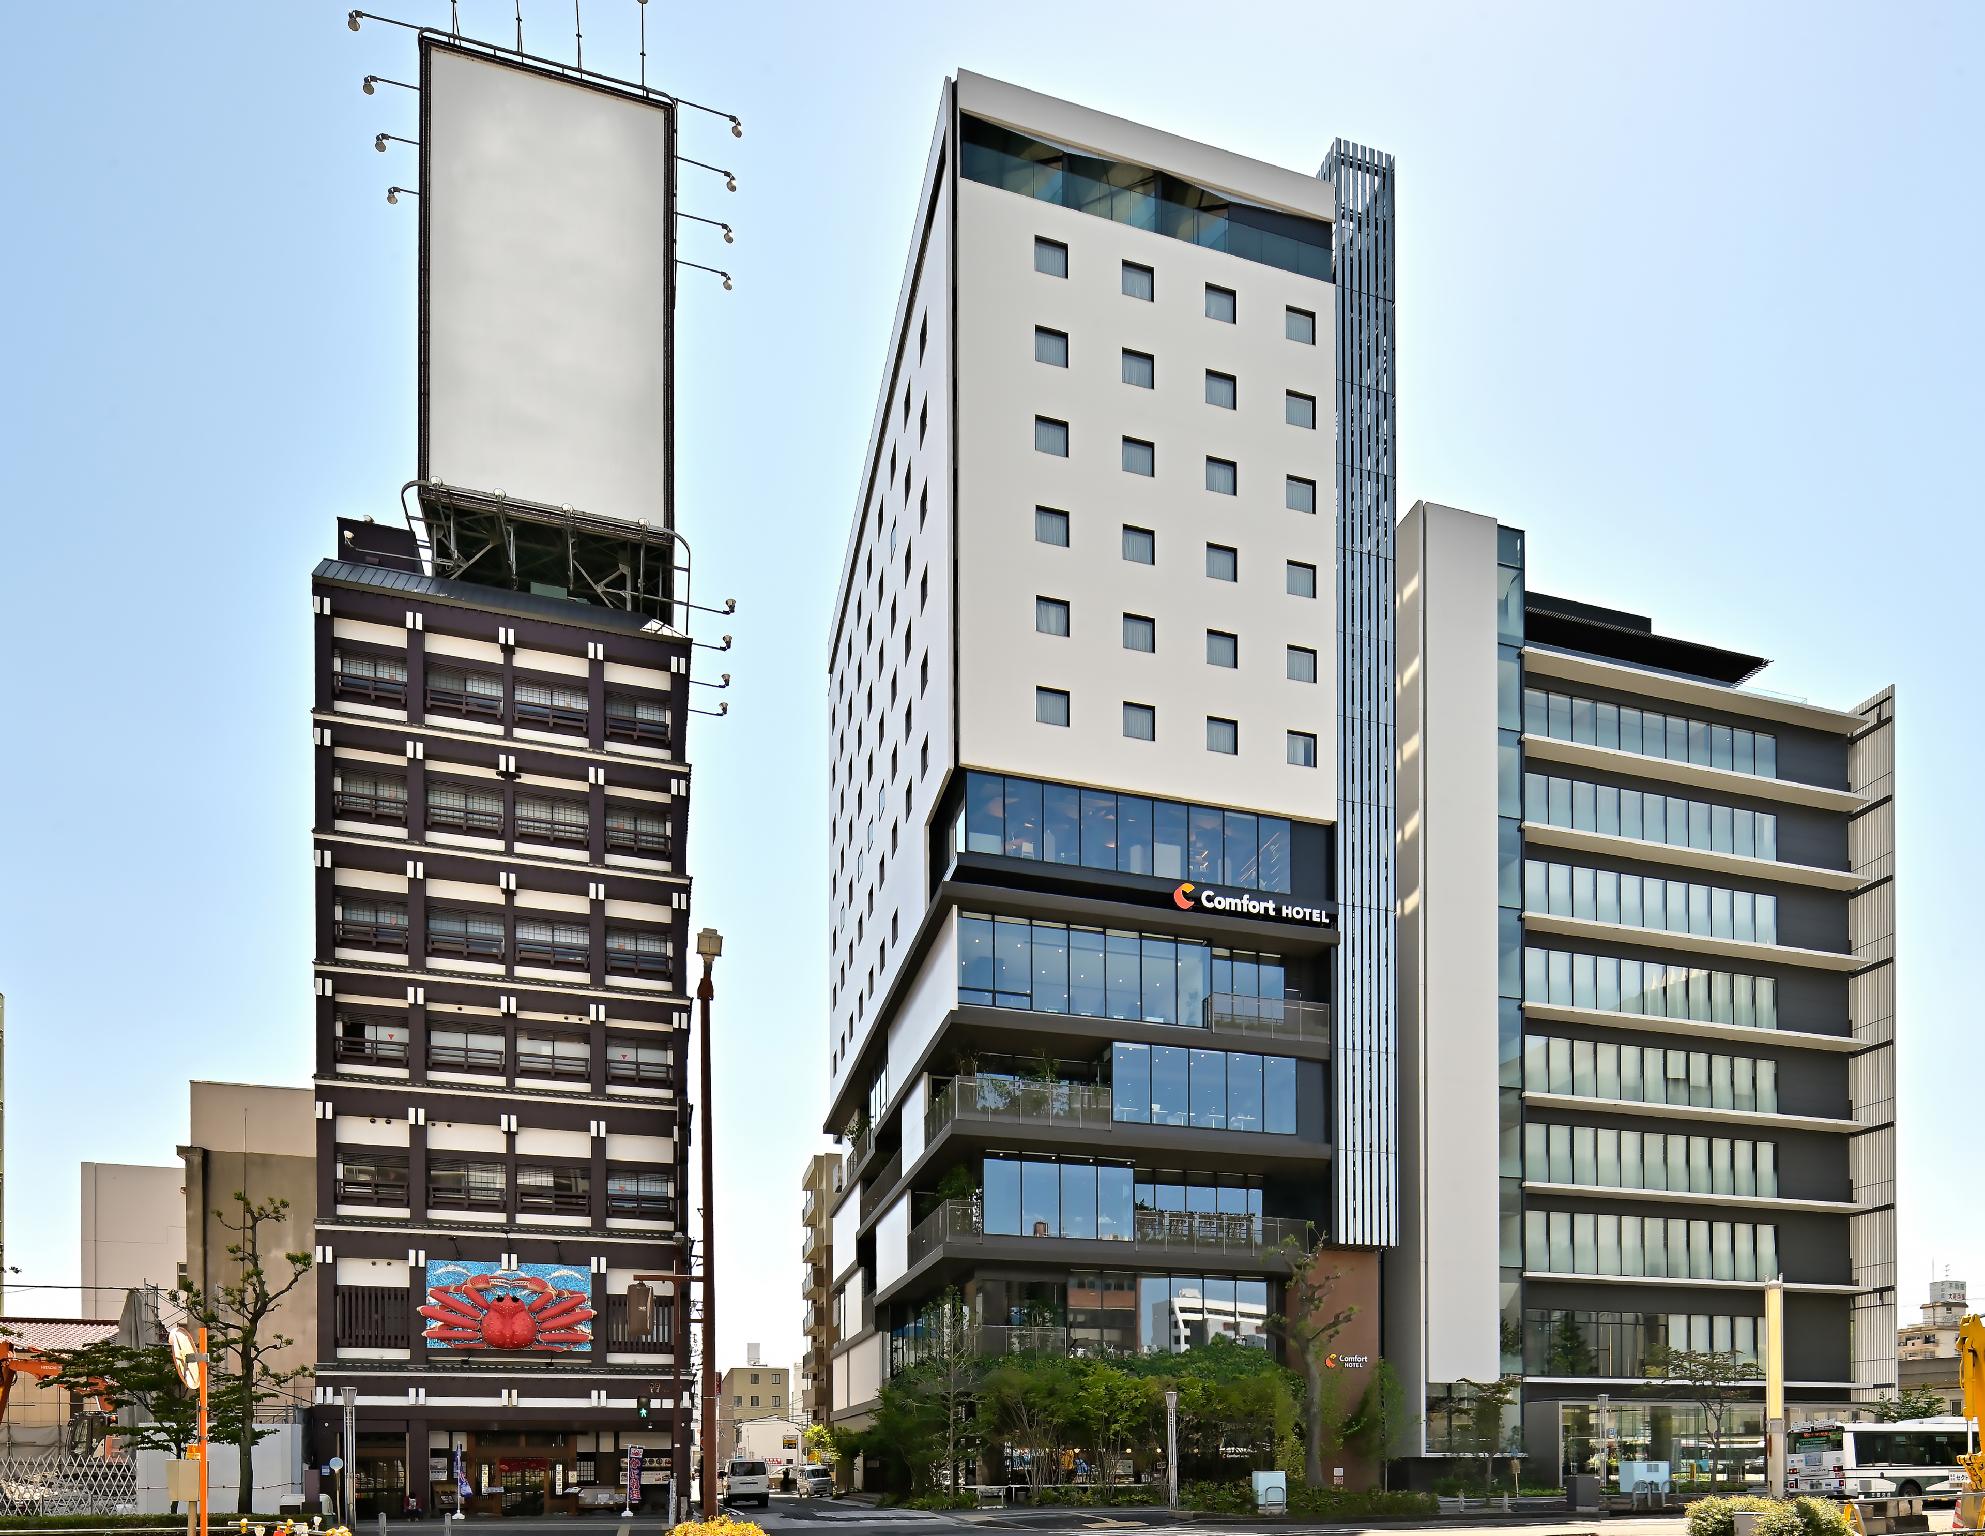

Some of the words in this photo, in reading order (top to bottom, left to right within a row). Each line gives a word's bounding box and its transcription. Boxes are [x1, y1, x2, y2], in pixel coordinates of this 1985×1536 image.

[1201, 890, 1276, 916] Comfort
[1281, 905, 1330, 924] HOTEL
[1339, 1354, 1368, 1363] Comfort
